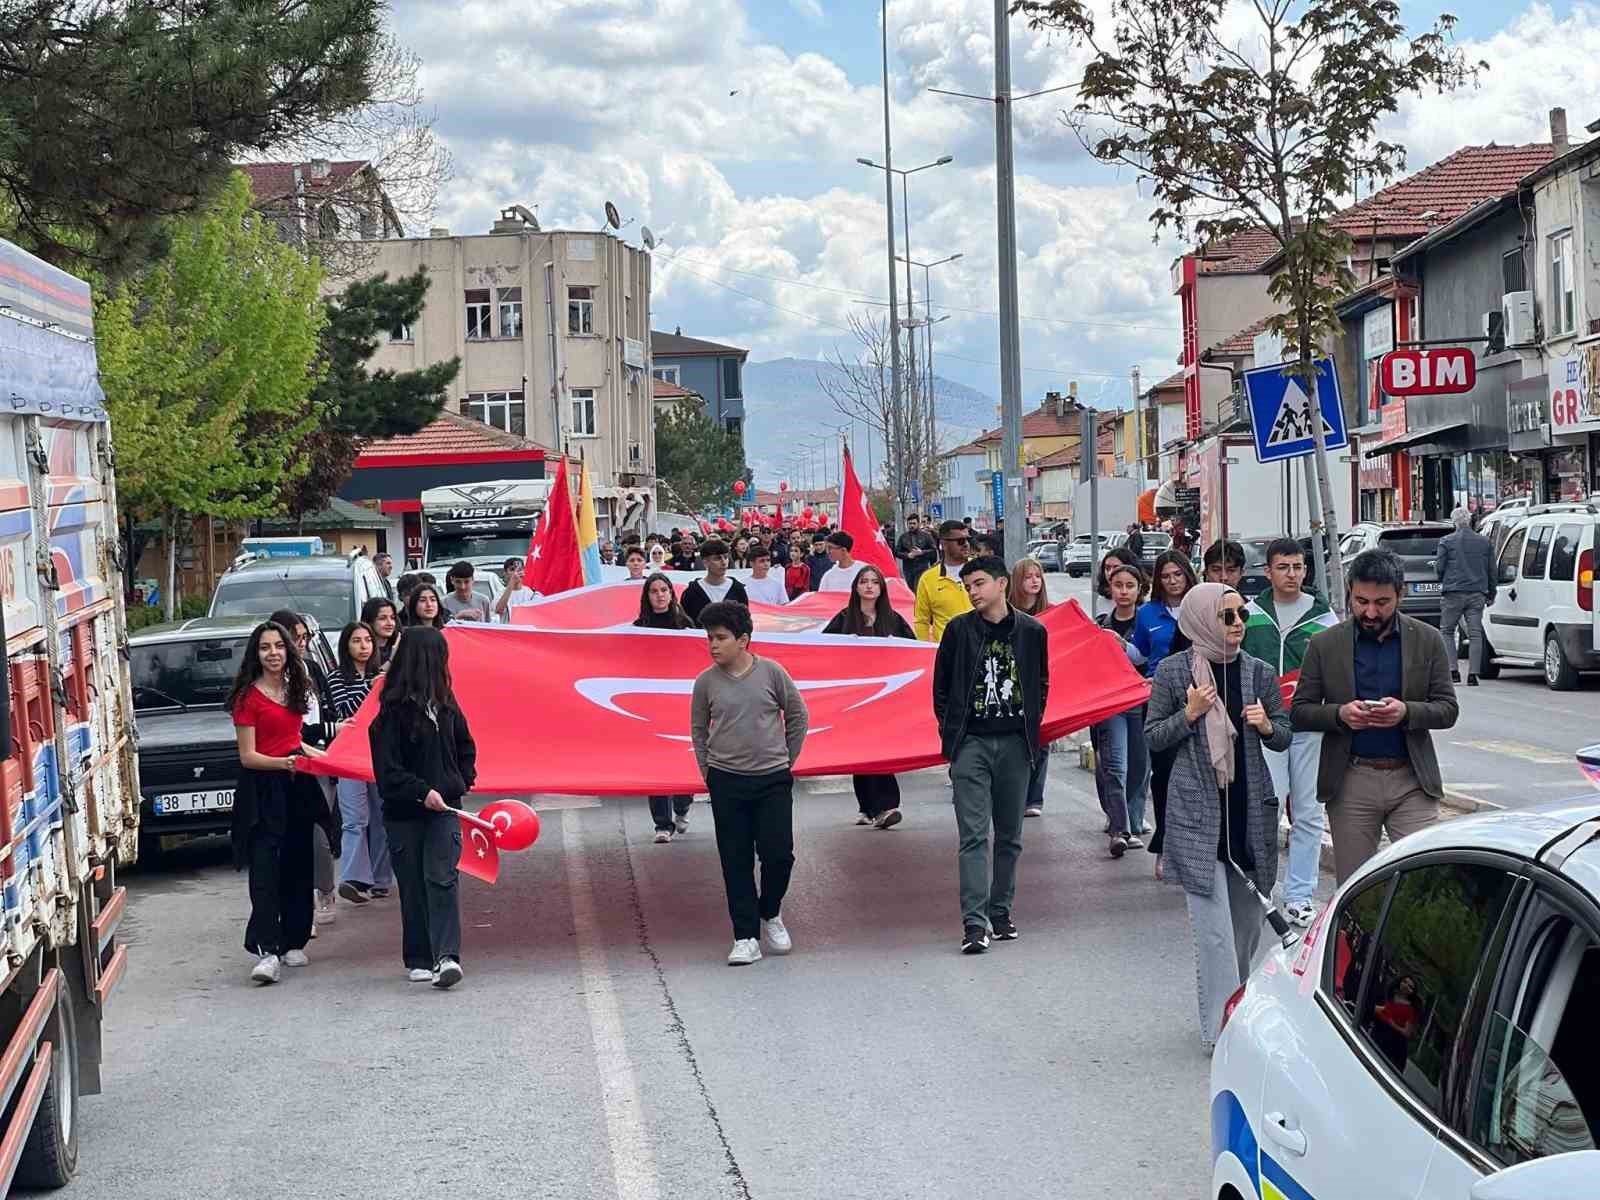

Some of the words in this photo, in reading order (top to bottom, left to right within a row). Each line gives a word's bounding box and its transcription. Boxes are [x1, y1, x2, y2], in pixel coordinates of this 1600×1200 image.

[1392, 350, 1467, 388] BİM
[163, 796, 179, 810] 38
[191, 793, 207, 808] FY
